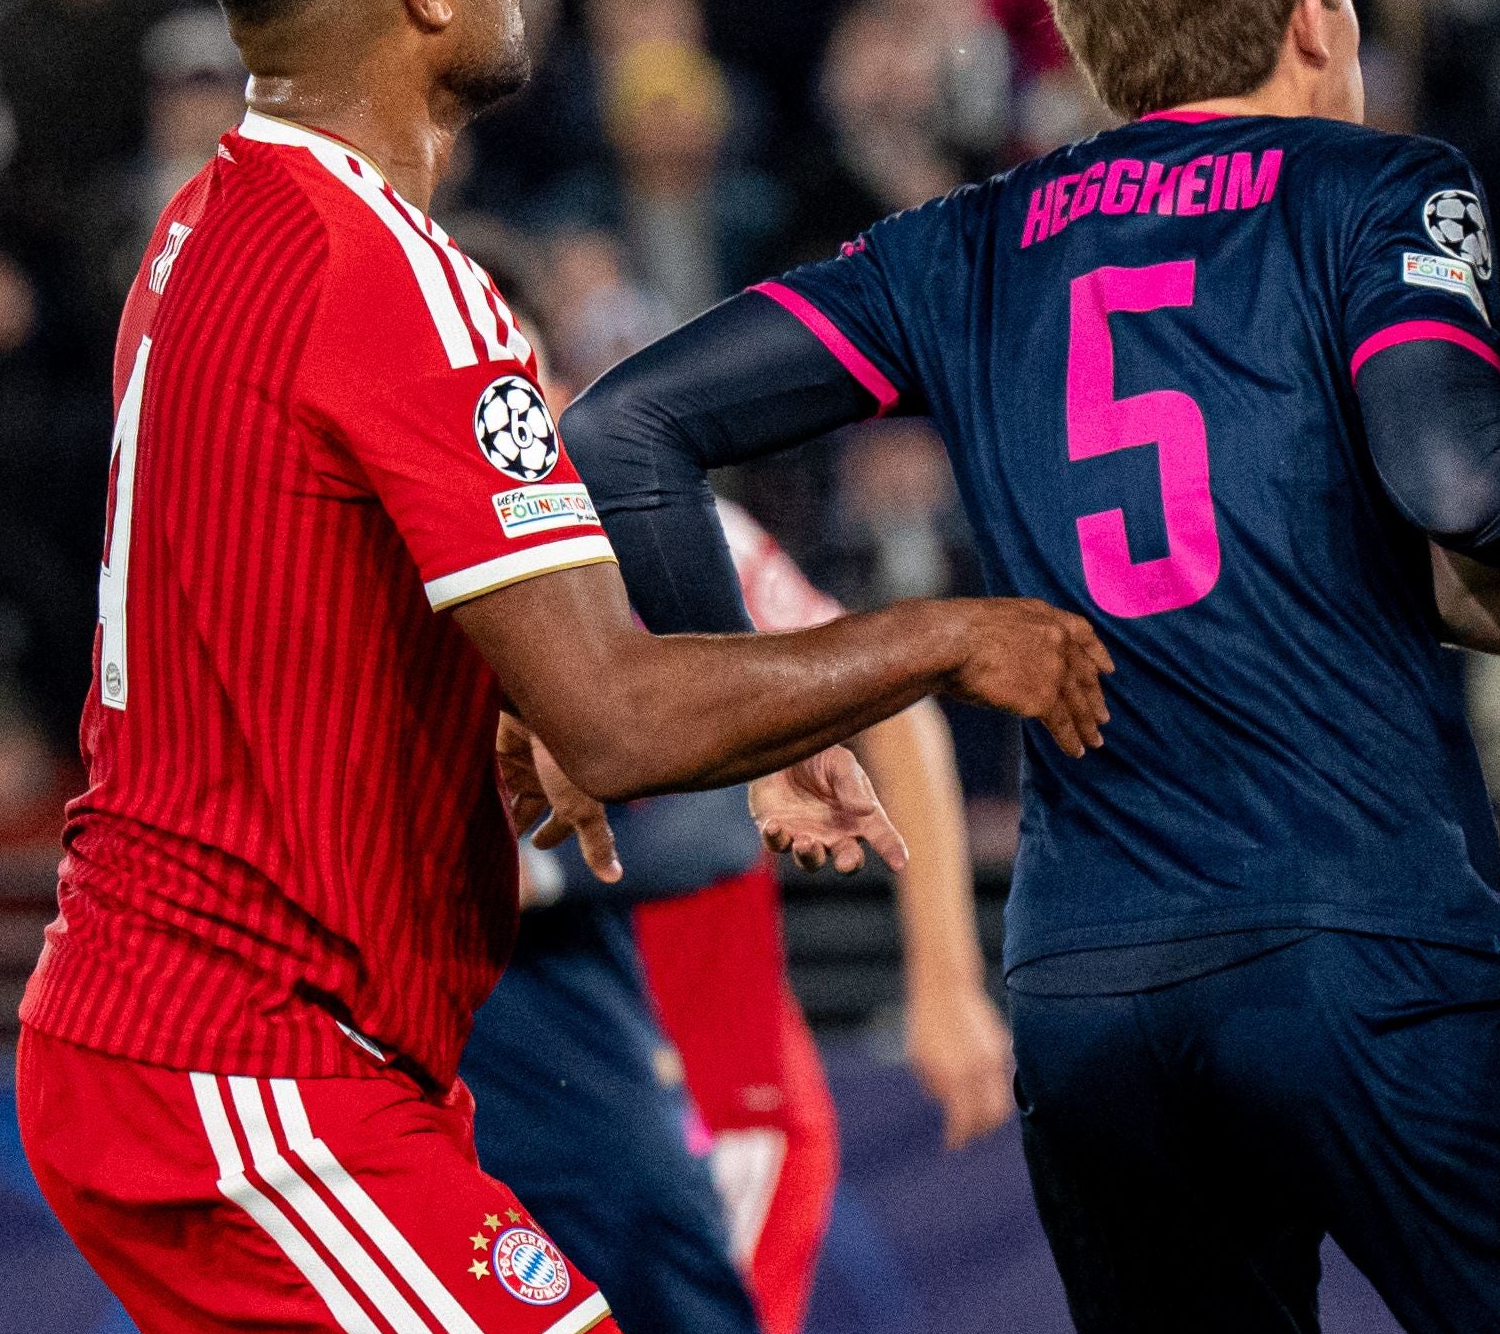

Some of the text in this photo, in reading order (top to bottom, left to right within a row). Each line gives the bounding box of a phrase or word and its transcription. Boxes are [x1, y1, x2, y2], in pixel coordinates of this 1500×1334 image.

[1020, 149, 1284, 249] HEGGHEIM
[510, 408, 534, 449] 6
[1066, 259, 1221, 619] 5
[497, 492, 526, 507] UEFA
[501, 496, 593, 523] FOUNDATION
